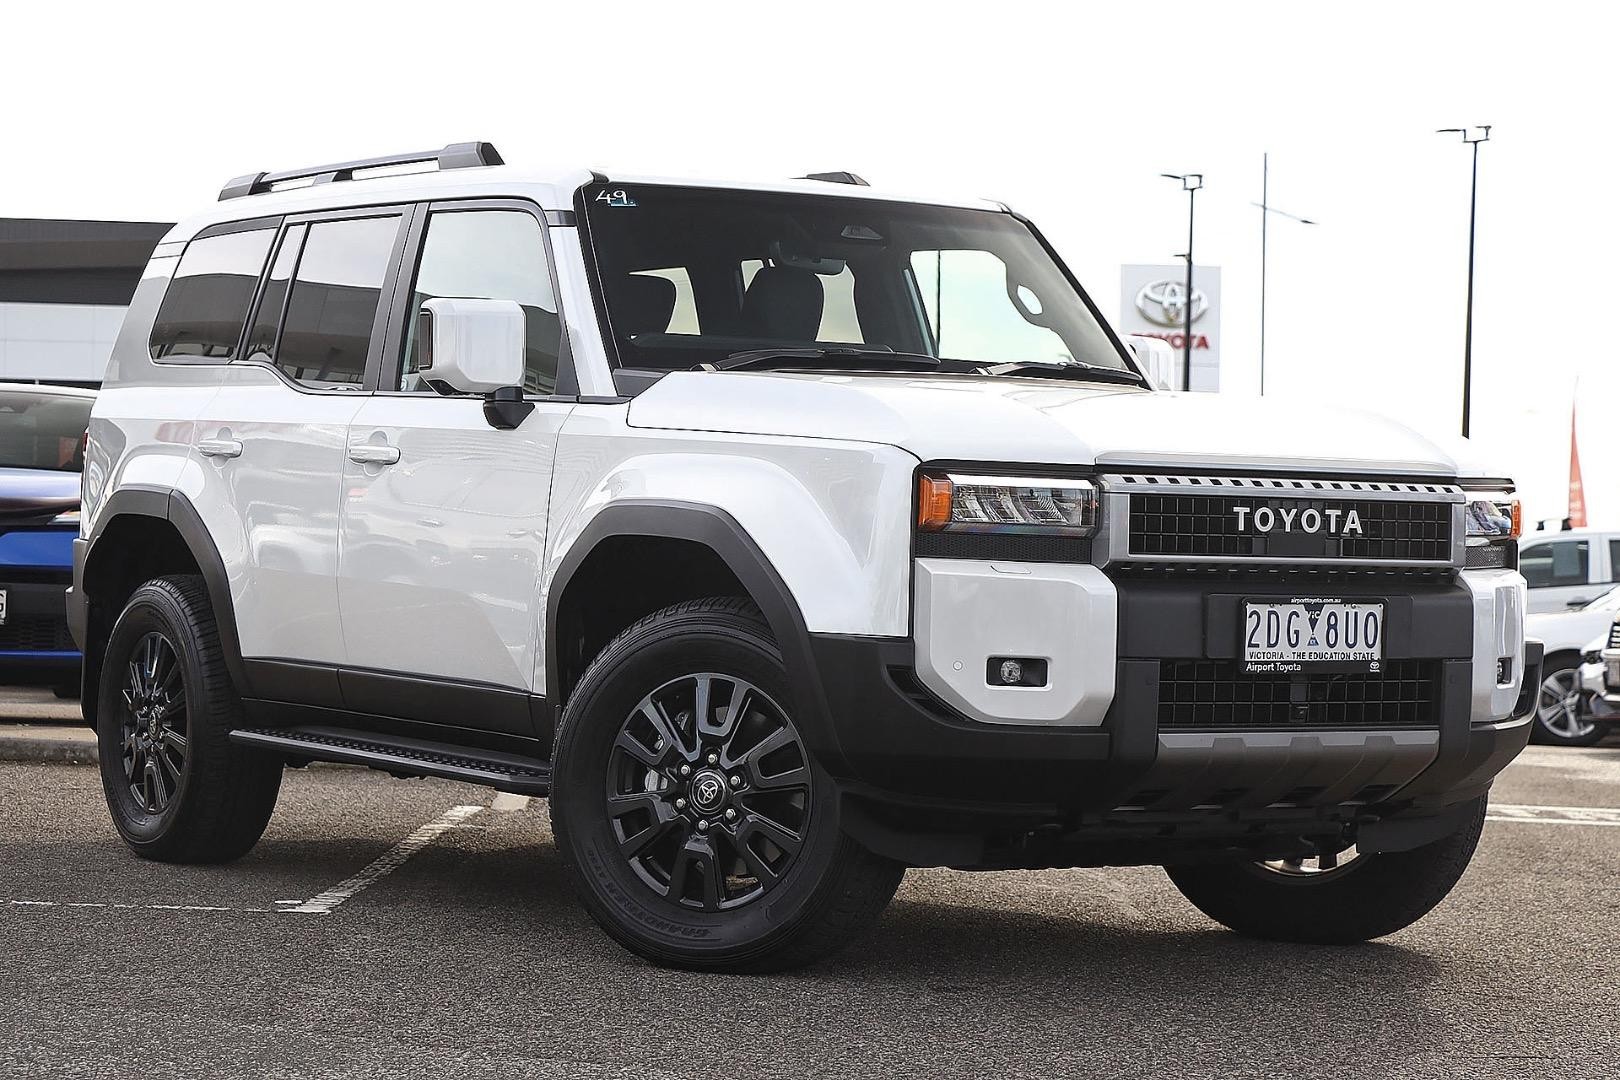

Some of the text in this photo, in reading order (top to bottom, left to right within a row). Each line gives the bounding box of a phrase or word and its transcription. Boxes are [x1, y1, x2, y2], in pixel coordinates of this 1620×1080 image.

[595, 189, 627, 204] 49
[1233, 506, 1363, 534] TOYOTA
[1290, 597, 1342, 605] airporttoyota.com.au
[1247, 610, 1300, 648] 2DG
[1249, 651, 1284, 660] VICTORIA
[1292, 651, 1305, 660] THE
[1309, 651, 1350, 660] EDUCATION
[1353, 651, 1375, 660] STATE
[1246, 662, 1302, 673] Airport Toyota
